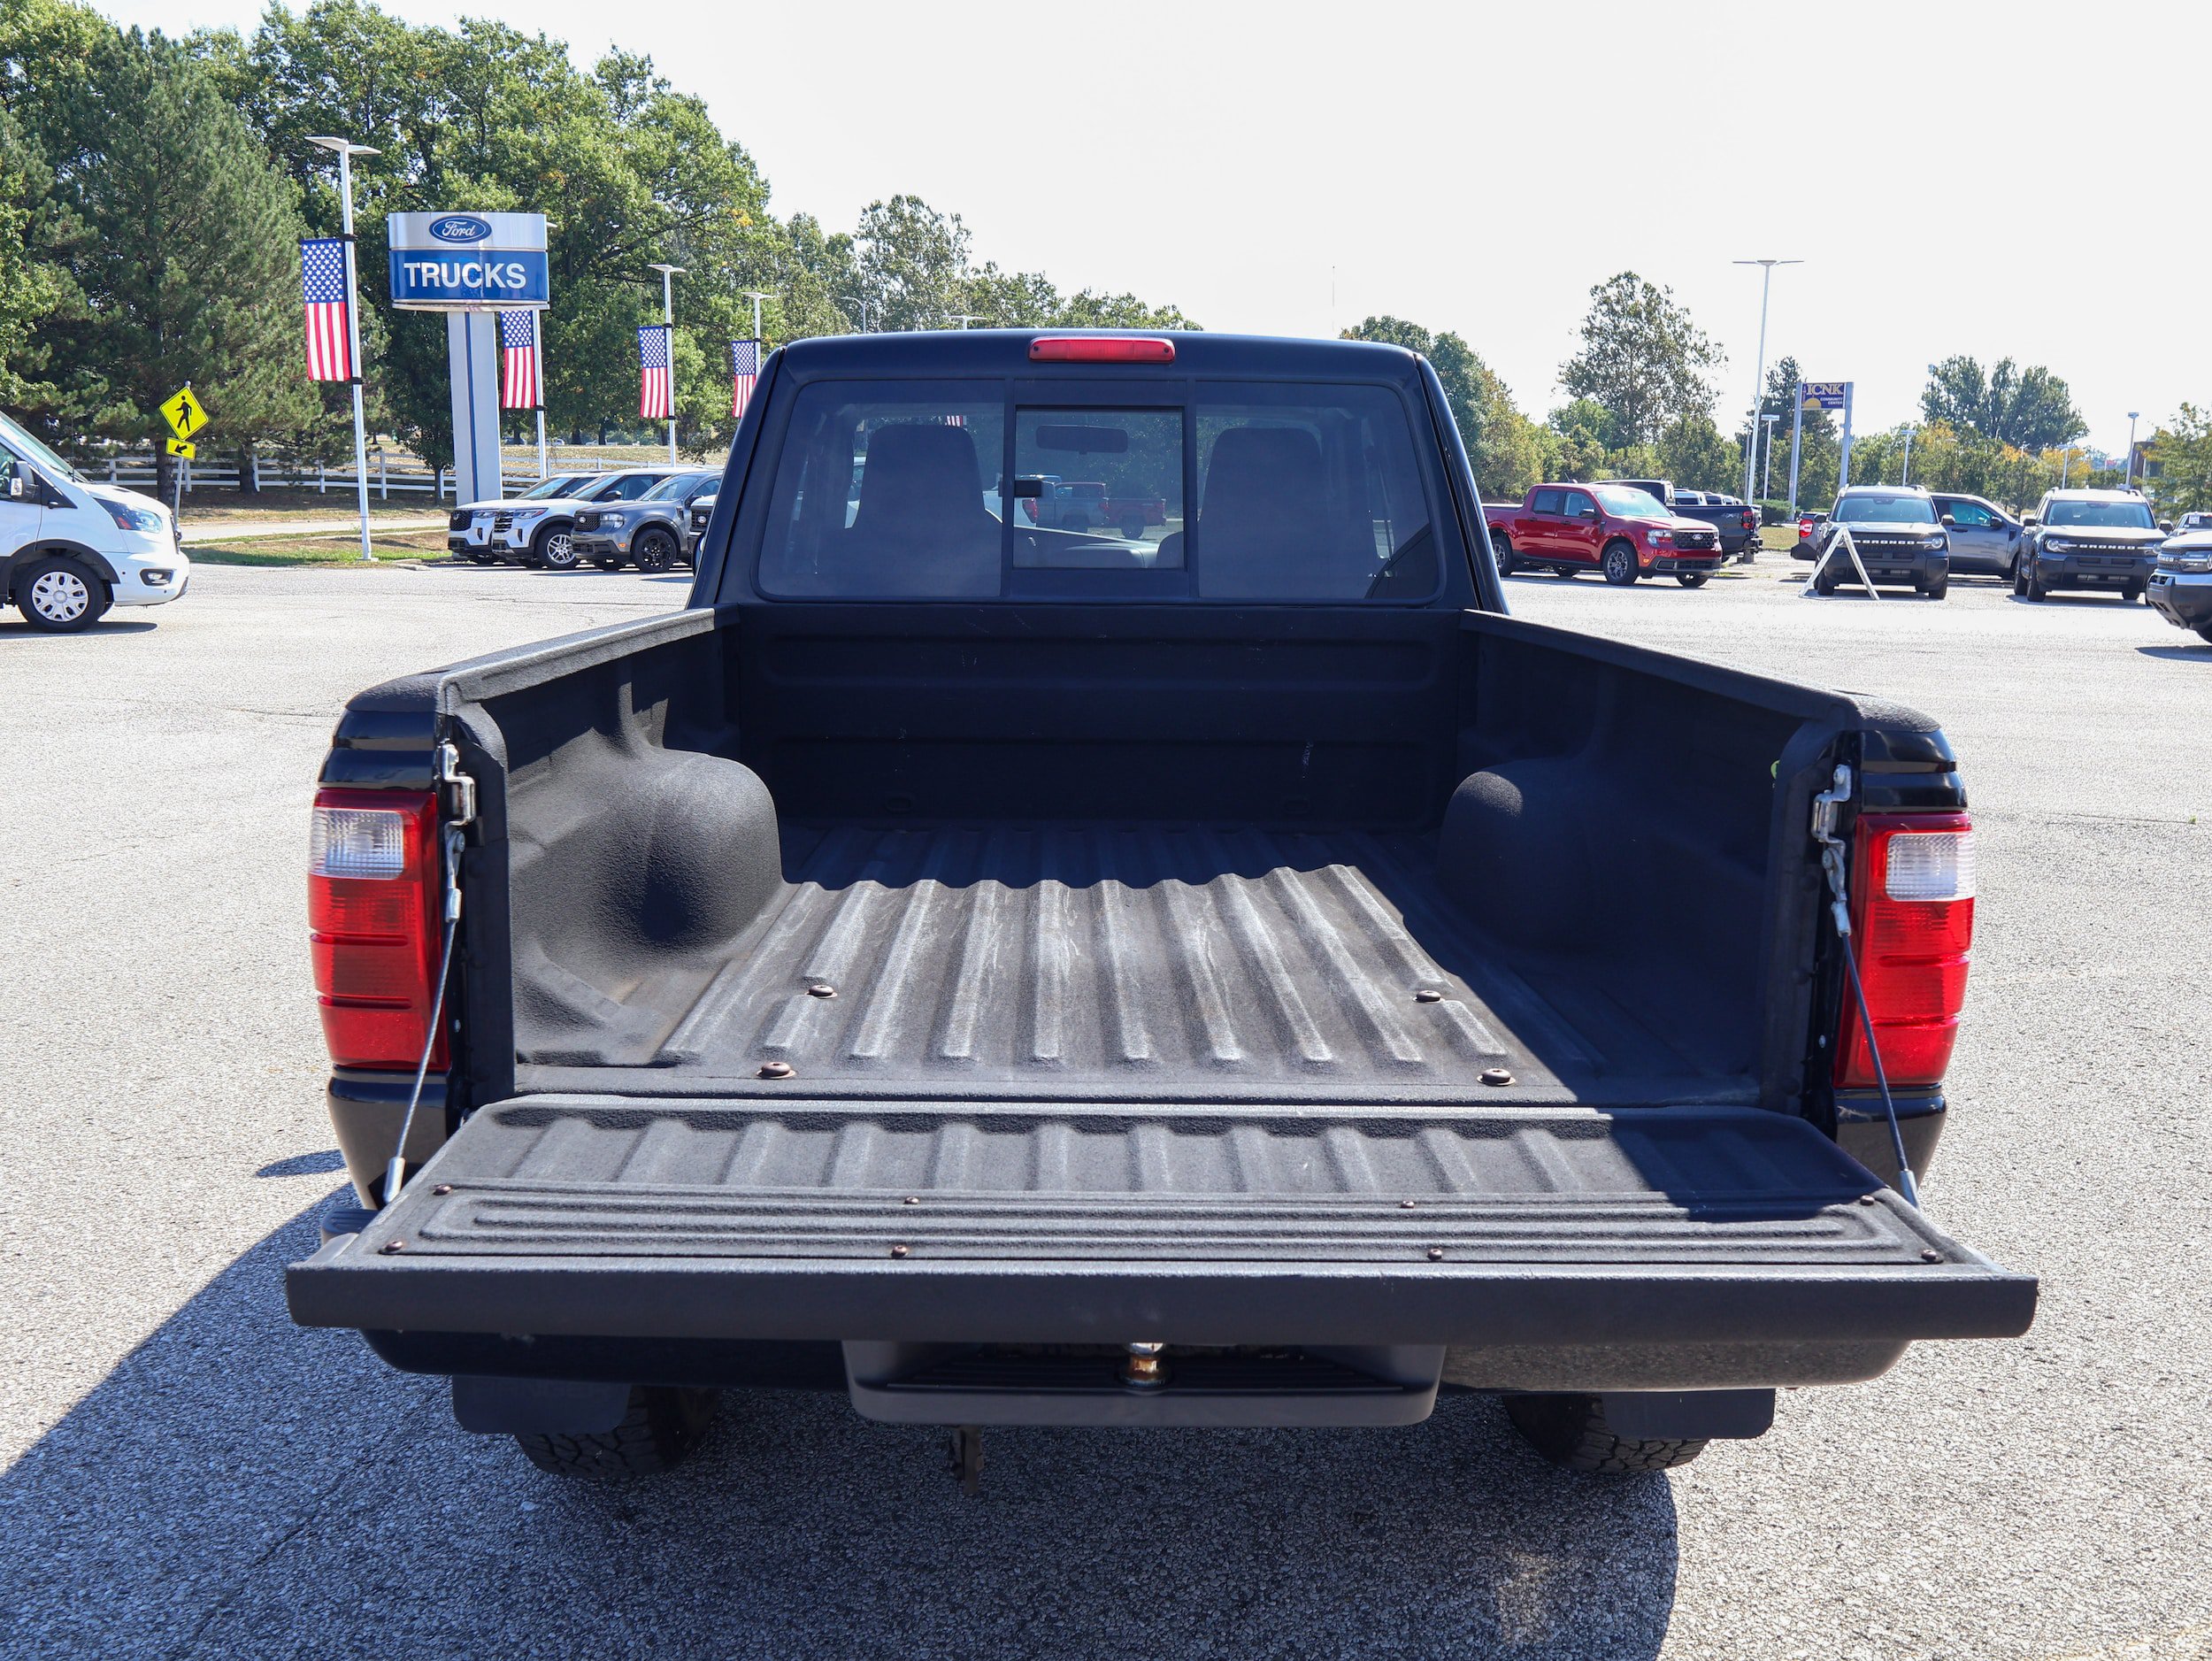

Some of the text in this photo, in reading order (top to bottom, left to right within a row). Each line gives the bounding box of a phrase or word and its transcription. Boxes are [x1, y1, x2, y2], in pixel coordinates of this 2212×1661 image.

[442, 220, 477, 237] Ford
[403, 262, 527, 289] TRUCKS
[1806, 383, 1844, 396] ICNK
